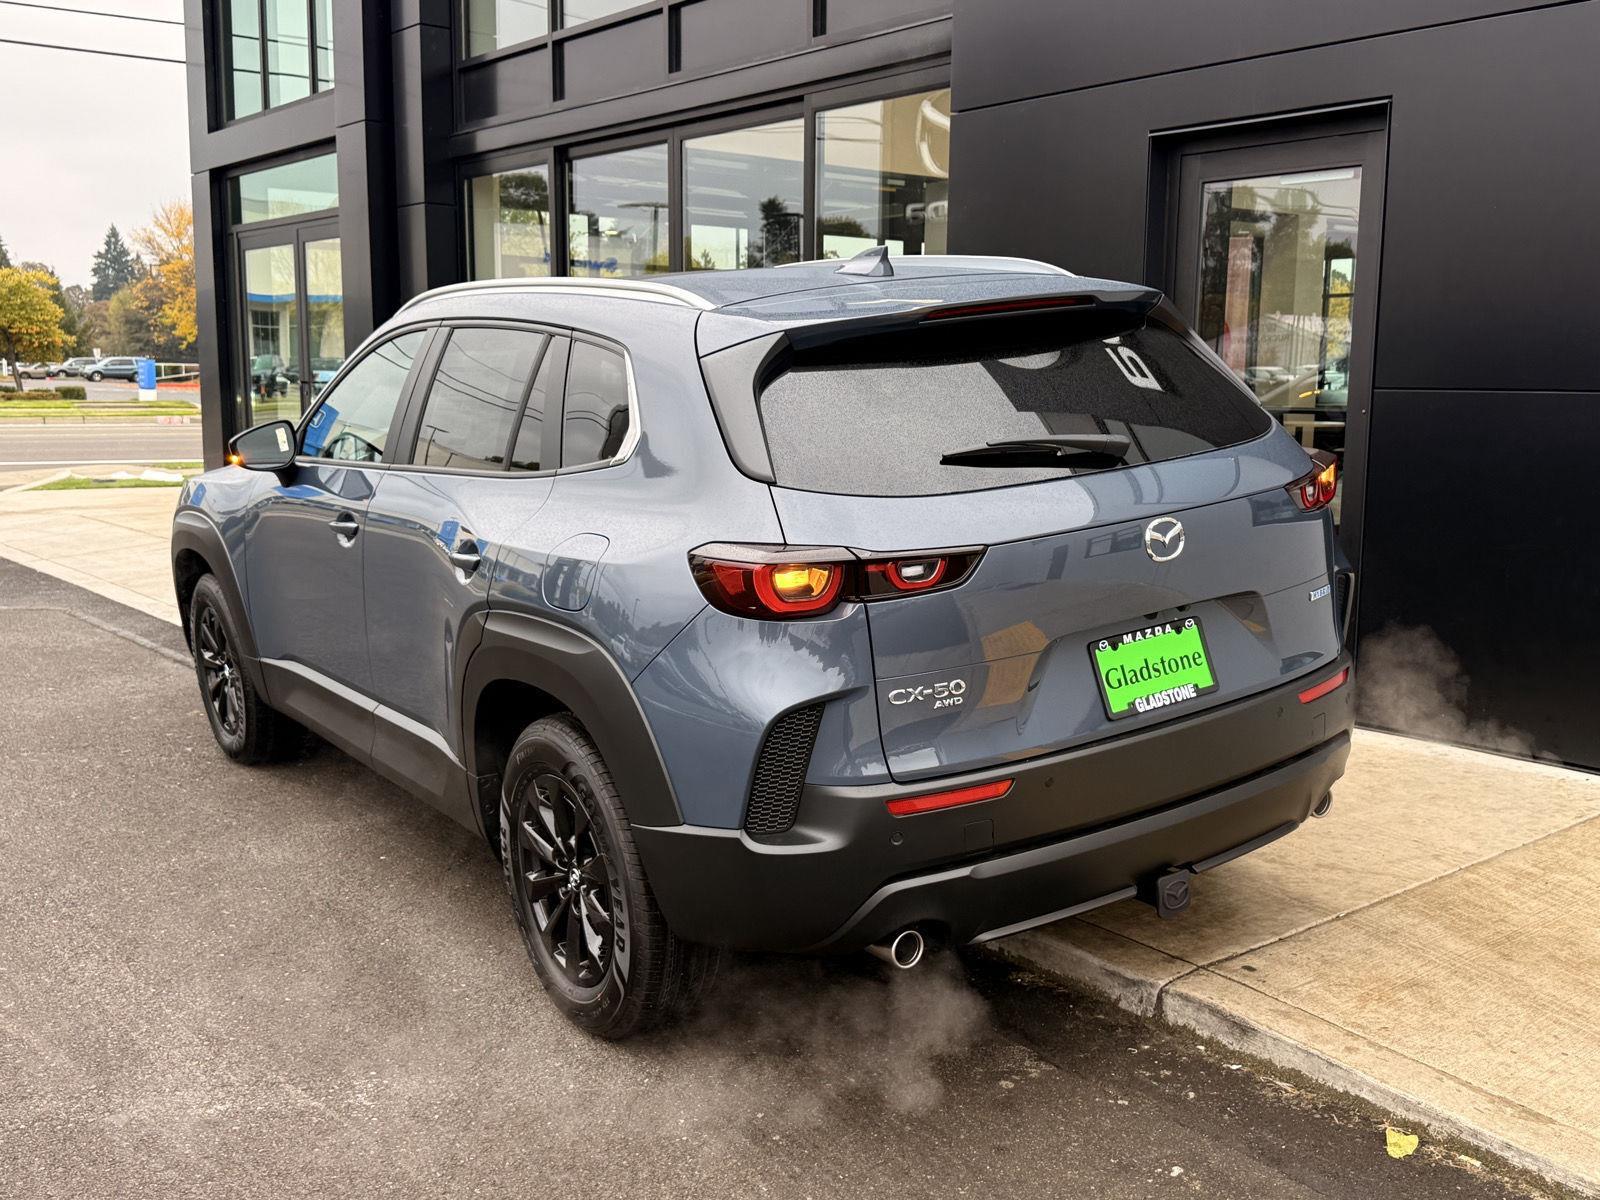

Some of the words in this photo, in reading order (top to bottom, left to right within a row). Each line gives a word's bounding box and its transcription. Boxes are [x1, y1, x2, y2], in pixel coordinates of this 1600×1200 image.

[1122, 624, 1173, 644] MAZDA
[1104, 651, 1203, 690] Gladstone
[888, 679, 966, 705] CX-50
[933, 696, 964, 709] AWD
[1135, 683, 1197, 713] GLADSTONE
